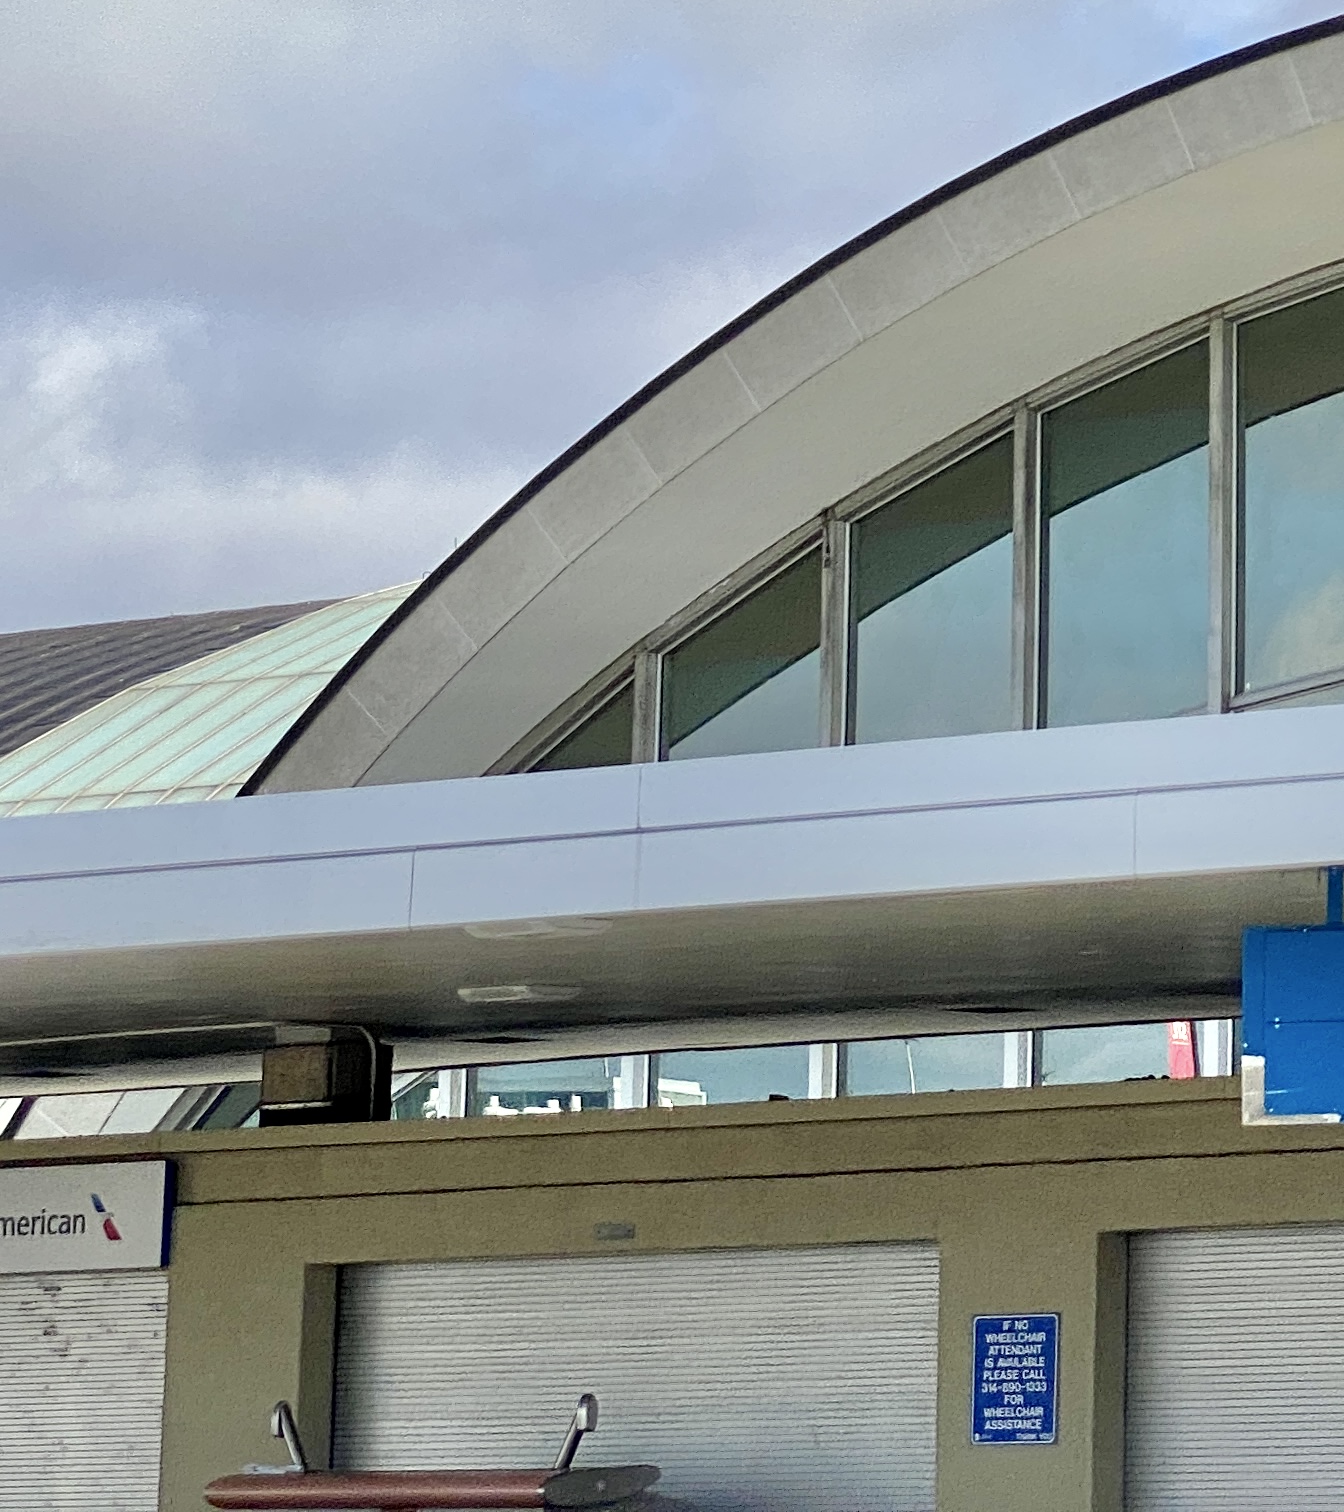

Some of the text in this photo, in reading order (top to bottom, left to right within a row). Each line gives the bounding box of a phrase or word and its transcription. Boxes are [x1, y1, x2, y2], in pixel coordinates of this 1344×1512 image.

[1002, 1320, 1029, 1330] IF NO
[985, 1332, 1047, 1343] WHEELCHAIR
[988, 1345, 1042, 1356] ATTENDANT
[984, 1357, 1045, 1368] IS AVAILABLE
[983, 1370, 1047, 1381] PLEASE CALL
[1004, 1395, 1024, 1405] FOR
[983, 1407, 1044, 1418] WHEELCHAIR
[985, 1419, 1042, 1430] ASSISTANCE
